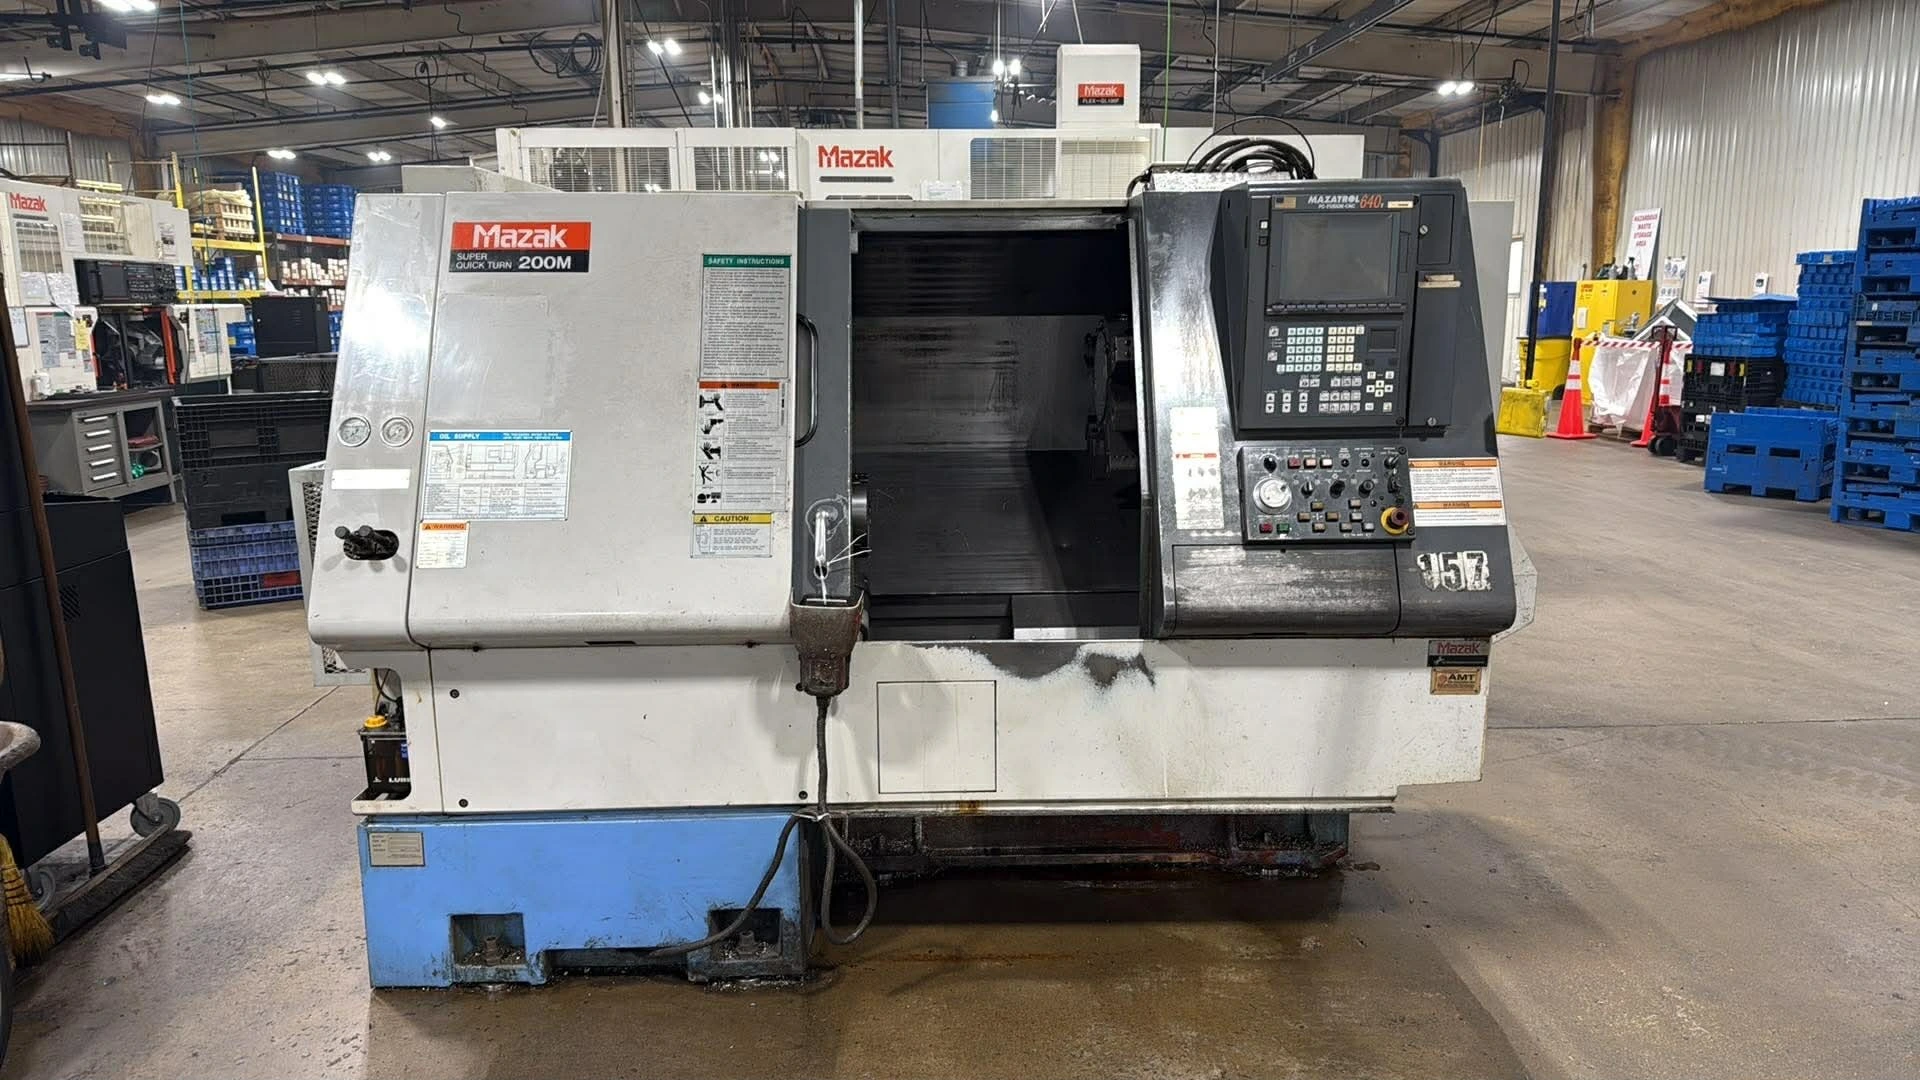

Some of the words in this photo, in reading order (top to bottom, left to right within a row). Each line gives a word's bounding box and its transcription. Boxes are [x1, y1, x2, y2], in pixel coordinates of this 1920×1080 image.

[1084, 85, 1118, 97] Mazak
[818, 145, 894, 168] Mazak
[9, 192, 47, 212] Mazak
[1308, 195, 1360, 204] MAZATROL
[472, 224, 568, 248] Mazak
[1633, 231, 1653, 239] STORAGE
[456, 252, 488, 260] SUPER
[708, 257, 733, 265] SAFETY
[737, 257, 785, 265] INSTRUCTIONS
[455, 261, 485, 269] QUICK
[488, 261, 513, 269] TURN
[518, 255, 572, 270] 200M
[1437, 642, 1481, 654] Mazak
[1448, 673, 1476, 681] AMT
